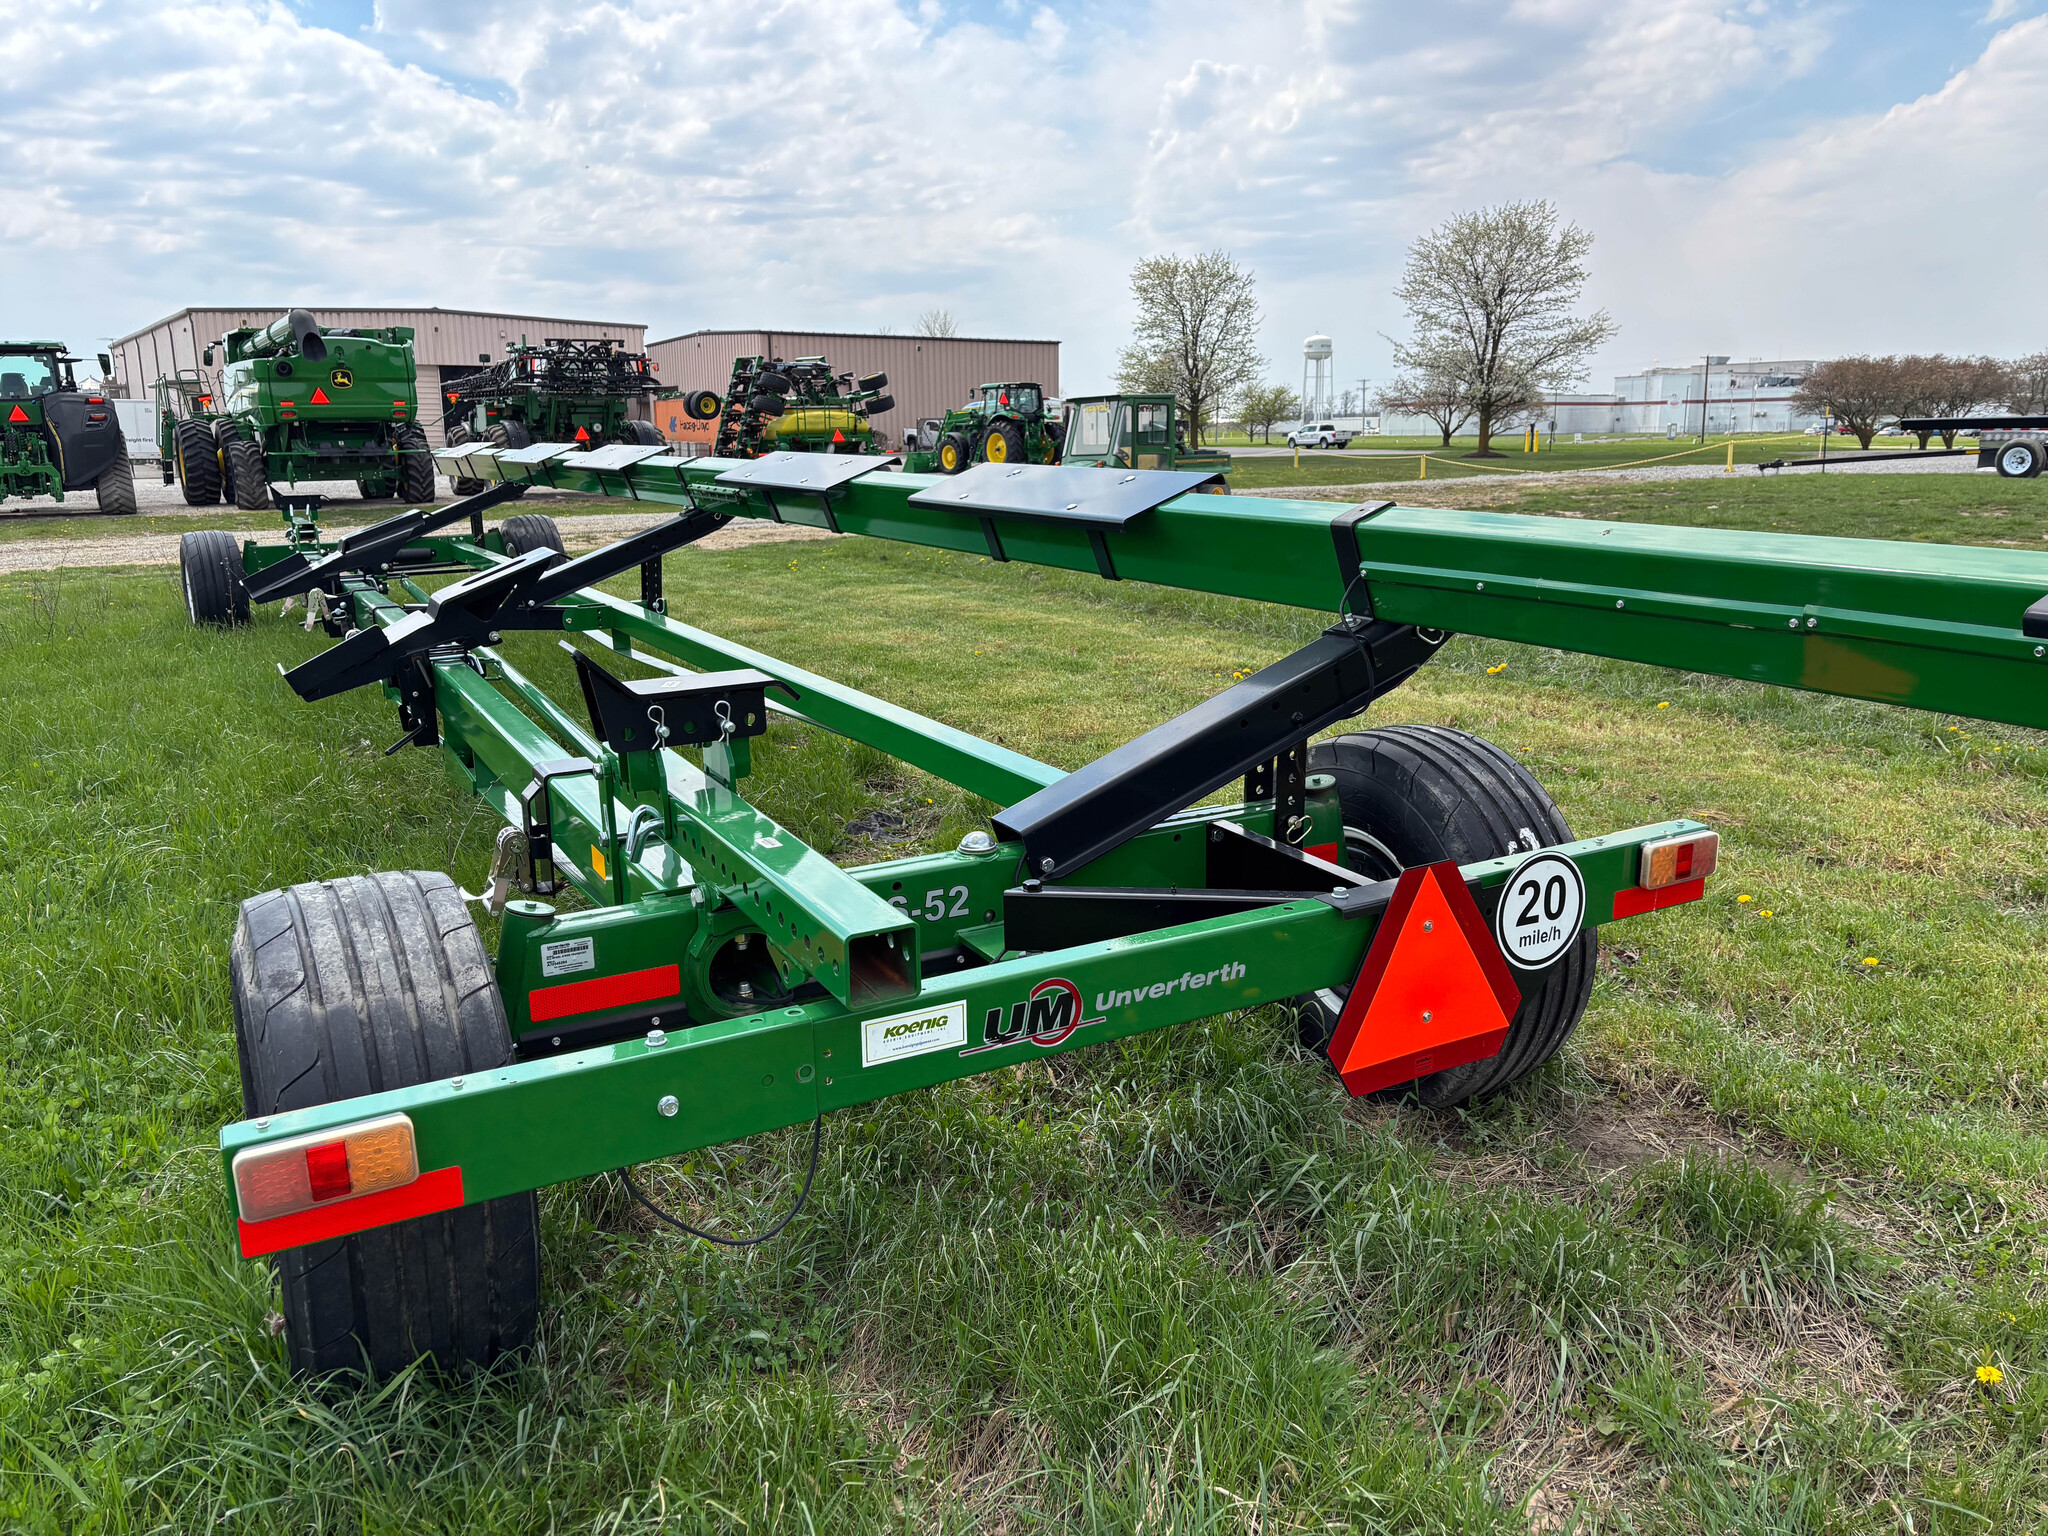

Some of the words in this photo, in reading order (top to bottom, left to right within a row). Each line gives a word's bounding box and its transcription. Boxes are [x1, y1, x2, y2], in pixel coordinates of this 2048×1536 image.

[1516, 875, 1566, 927] 20
[1519, 926, 1560, 948] mile/h
[1095, 961, 1246, 1011] Unverferth
[983, 990, 1075, 1044] UM
